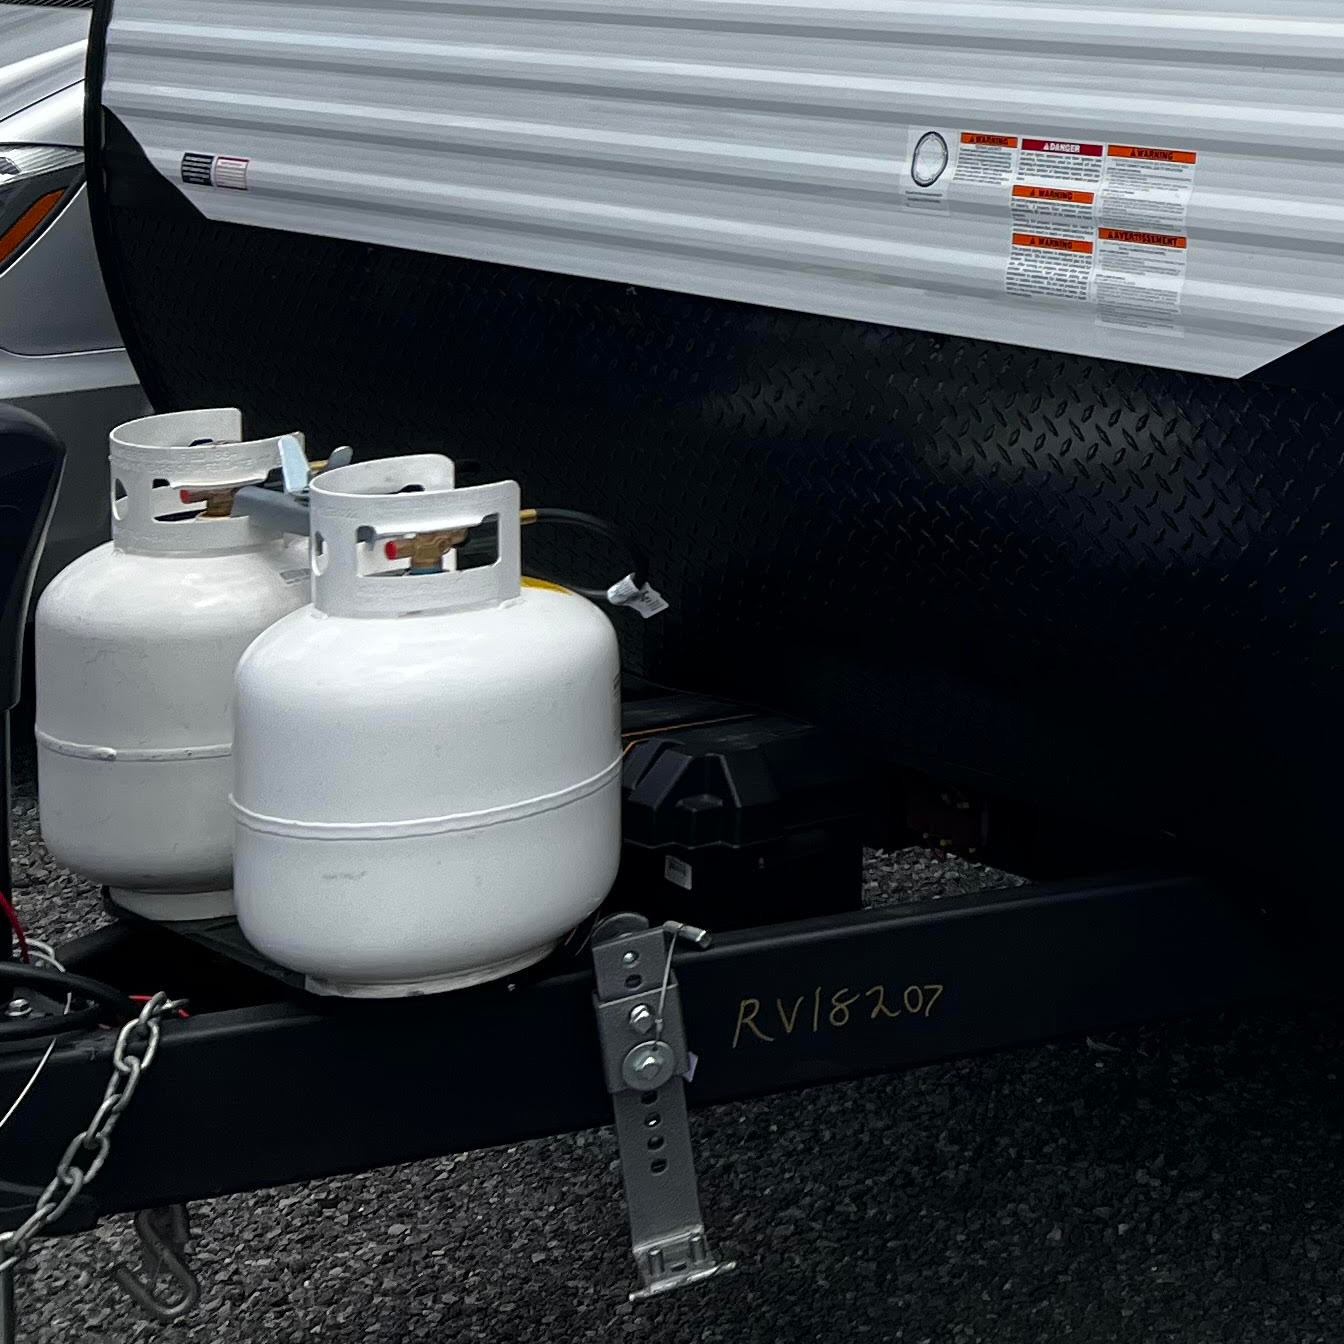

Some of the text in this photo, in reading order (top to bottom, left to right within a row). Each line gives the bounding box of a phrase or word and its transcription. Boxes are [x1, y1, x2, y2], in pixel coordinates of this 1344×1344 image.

[1049, 142, 1081, 153] DANGER
[1137, 147, 1174, 161] WARNING
[1038, 189, 1073, 200] WARNING
[732, 984, 944, 1049] RV18207
